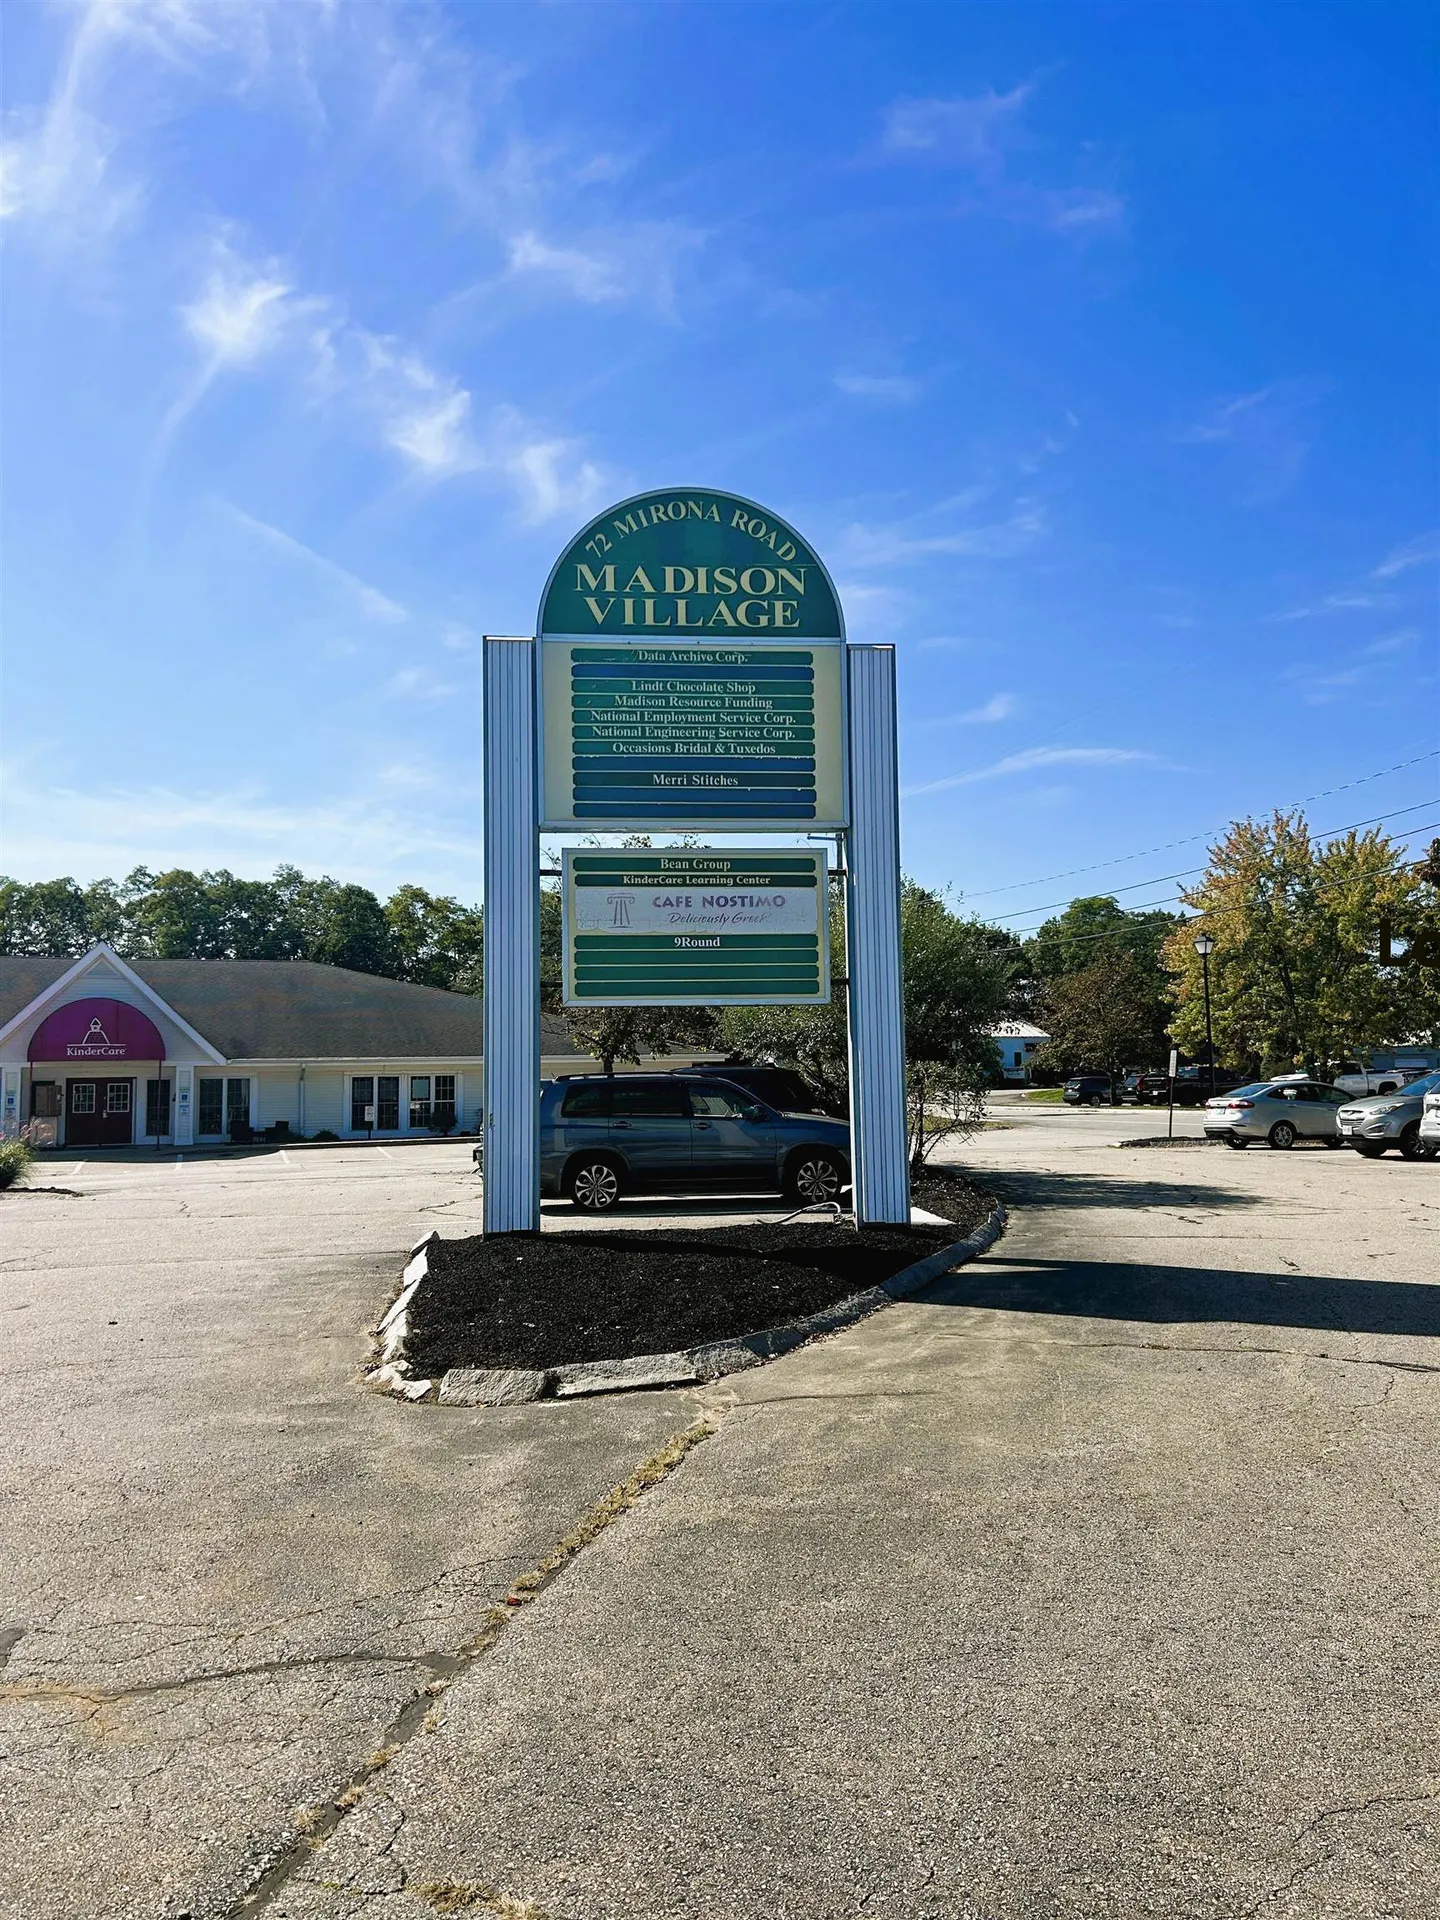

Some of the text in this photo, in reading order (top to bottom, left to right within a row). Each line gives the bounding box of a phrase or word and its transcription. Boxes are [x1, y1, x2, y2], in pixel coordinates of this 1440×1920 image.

[585, 500, 797, 562] 72 MIRONA ROAD
[573, 564, 807, 596] MADISON
[583, 598, 801, 629] VILLAGE
[638, 650, 666, 662] Data
[716, 652, 748, 664] Corp.
[631, 680, 756, 695] Lindt Chocolate Shop
[614, 695, 773, 710] Madison Resource Funding
[591, 710, 797, 726] National Employment Service Corp.
[592, 726, 796, 740] National Engineering Service Corp.
[612, 742, 776, 755] Occasions Bridal & Tuxedos
[653, 774, 739, 786] Merri Stitches
[660, 858, 731, 871] Bean Group
[623, 875, 771, 886] KinderCare Learning Center
[652, 895, 786, 908] CAFE NOSTIMO
[668, 912, 730, 928] Deliciously
[674, 937, 721, 947] 9Round
[66, 1047, 126, 1056] KinderCare
